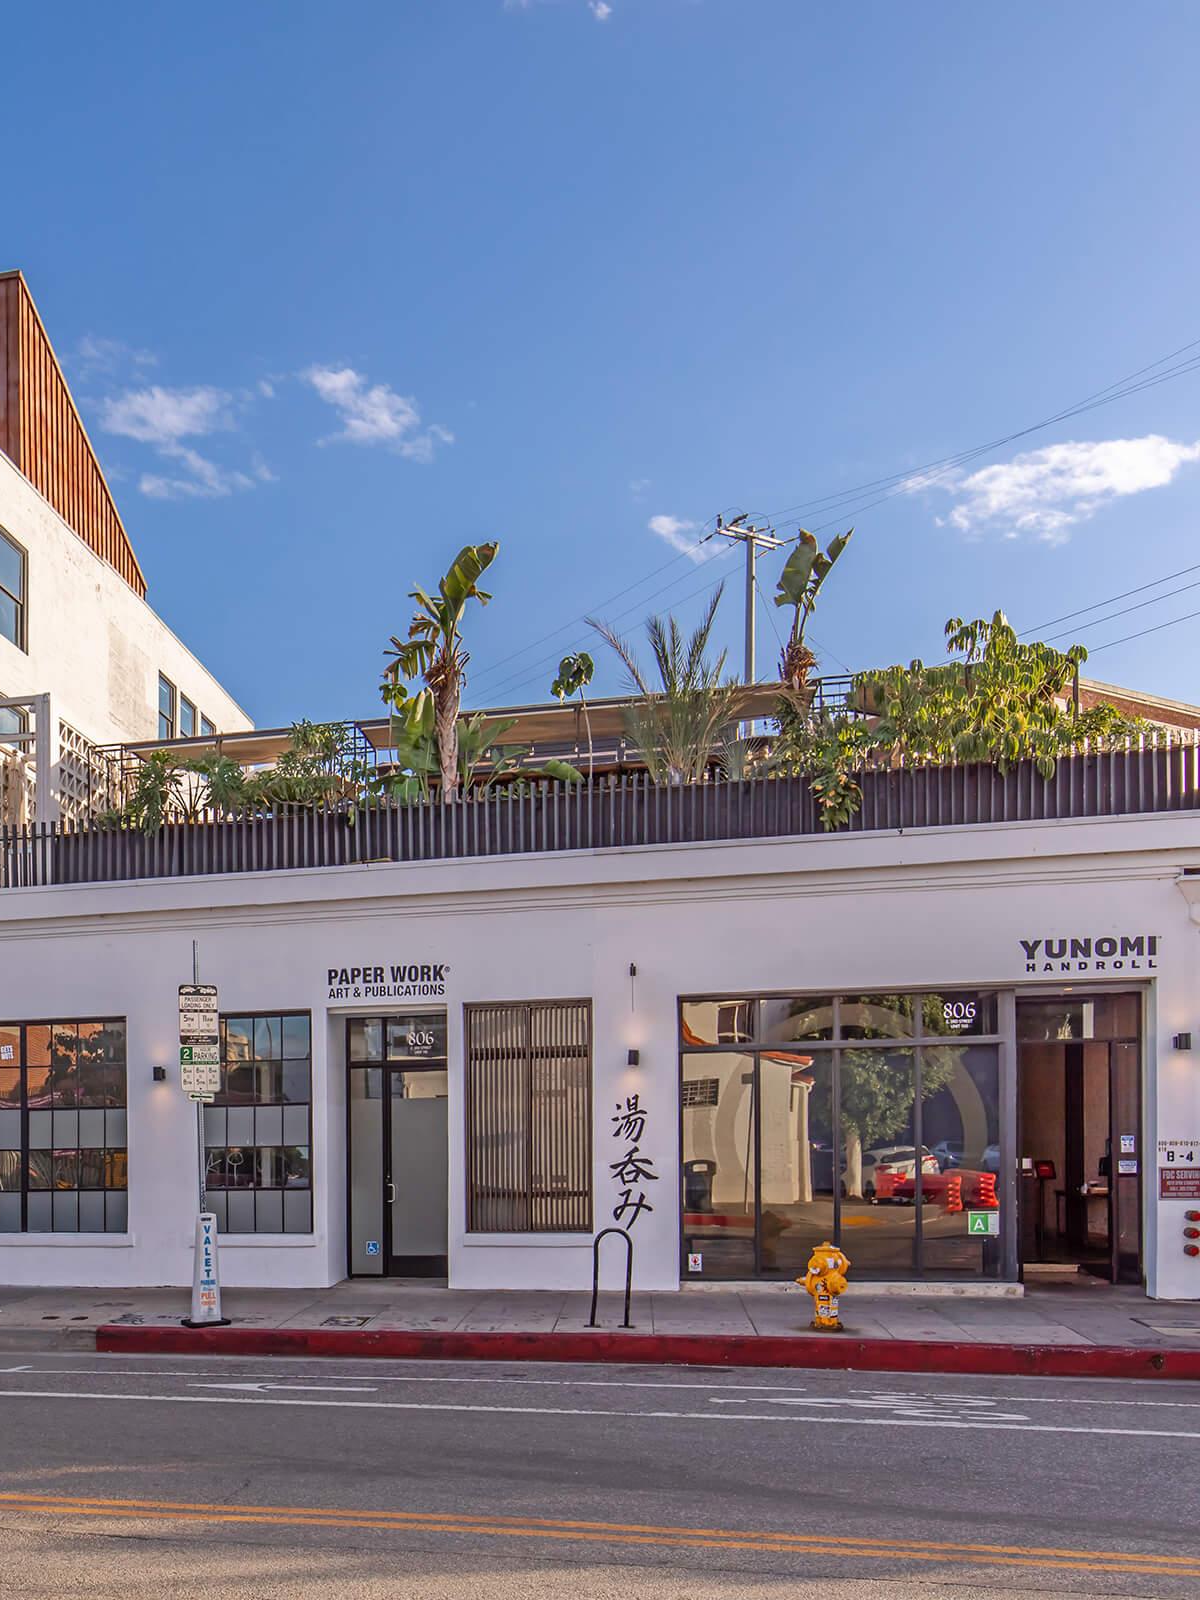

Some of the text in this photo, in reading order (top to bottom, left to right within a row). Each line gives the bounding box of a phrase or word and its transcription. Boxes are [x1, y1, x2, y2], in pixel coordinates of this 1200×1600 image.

[1019, 935, 1157, 960] YUNOMI
[1026, 960, 1158, 972] HANDROLL
[327, 967, 385, 986] PAPER
[328, 984, 445, 999] ART & PUBLICATIONS
[943, 1002, 977, 1019] 806
[408, 1031, 435, 1046] 806
[183, 1049, 190, 1059] 2
[193, 1051, 218, 1061] PARKING
[609, 1094, 659, 1231] 湯呑み
[1162, 1170, 1176, 1180] FDC
[973, 1218, 985, 1231] A
[203, 1225, 212, 1278] VALET
[201, 1292, 216, 1300] PULL
